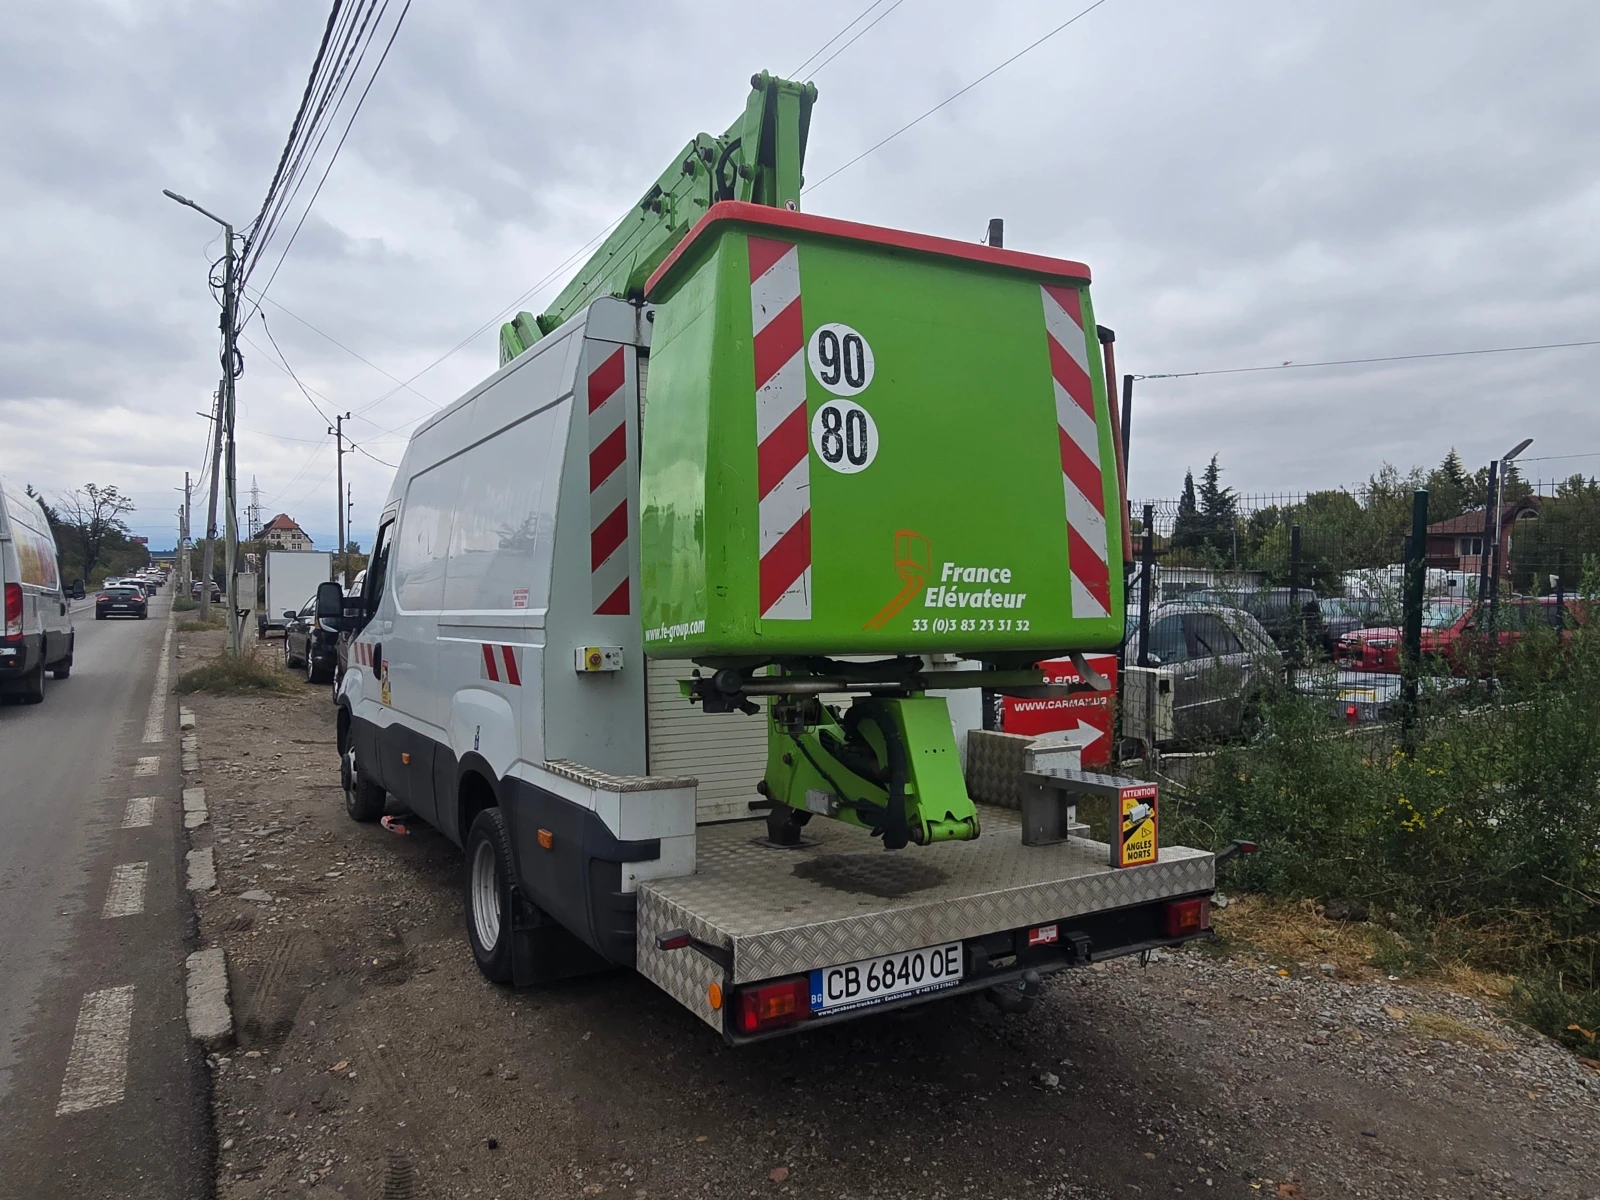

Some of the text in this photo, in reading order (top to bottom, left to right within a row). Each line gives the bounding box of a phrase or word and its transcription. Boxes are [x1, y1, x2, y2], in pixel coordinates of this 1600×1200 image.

[818, 330, 866, 389] 90
[821, 406, 868, 466] 80
[940, 562, 1012, 584] France
[924, 585, 1027, 609] Elévateur
[645, 619, 706, 643] www.fe-group.com
[911, 618, 1030, 634] 33 (0)3 83 23 31 32
[1122, 787, 1156, 798] ATTENTION
[1126, 840, 1152, 852] ANGLES
[1127, 849, 1151, 861] MORTS
[828, 945, 959, 1000] CB 6840 OE
[811, 993, 823, 1004] BG
